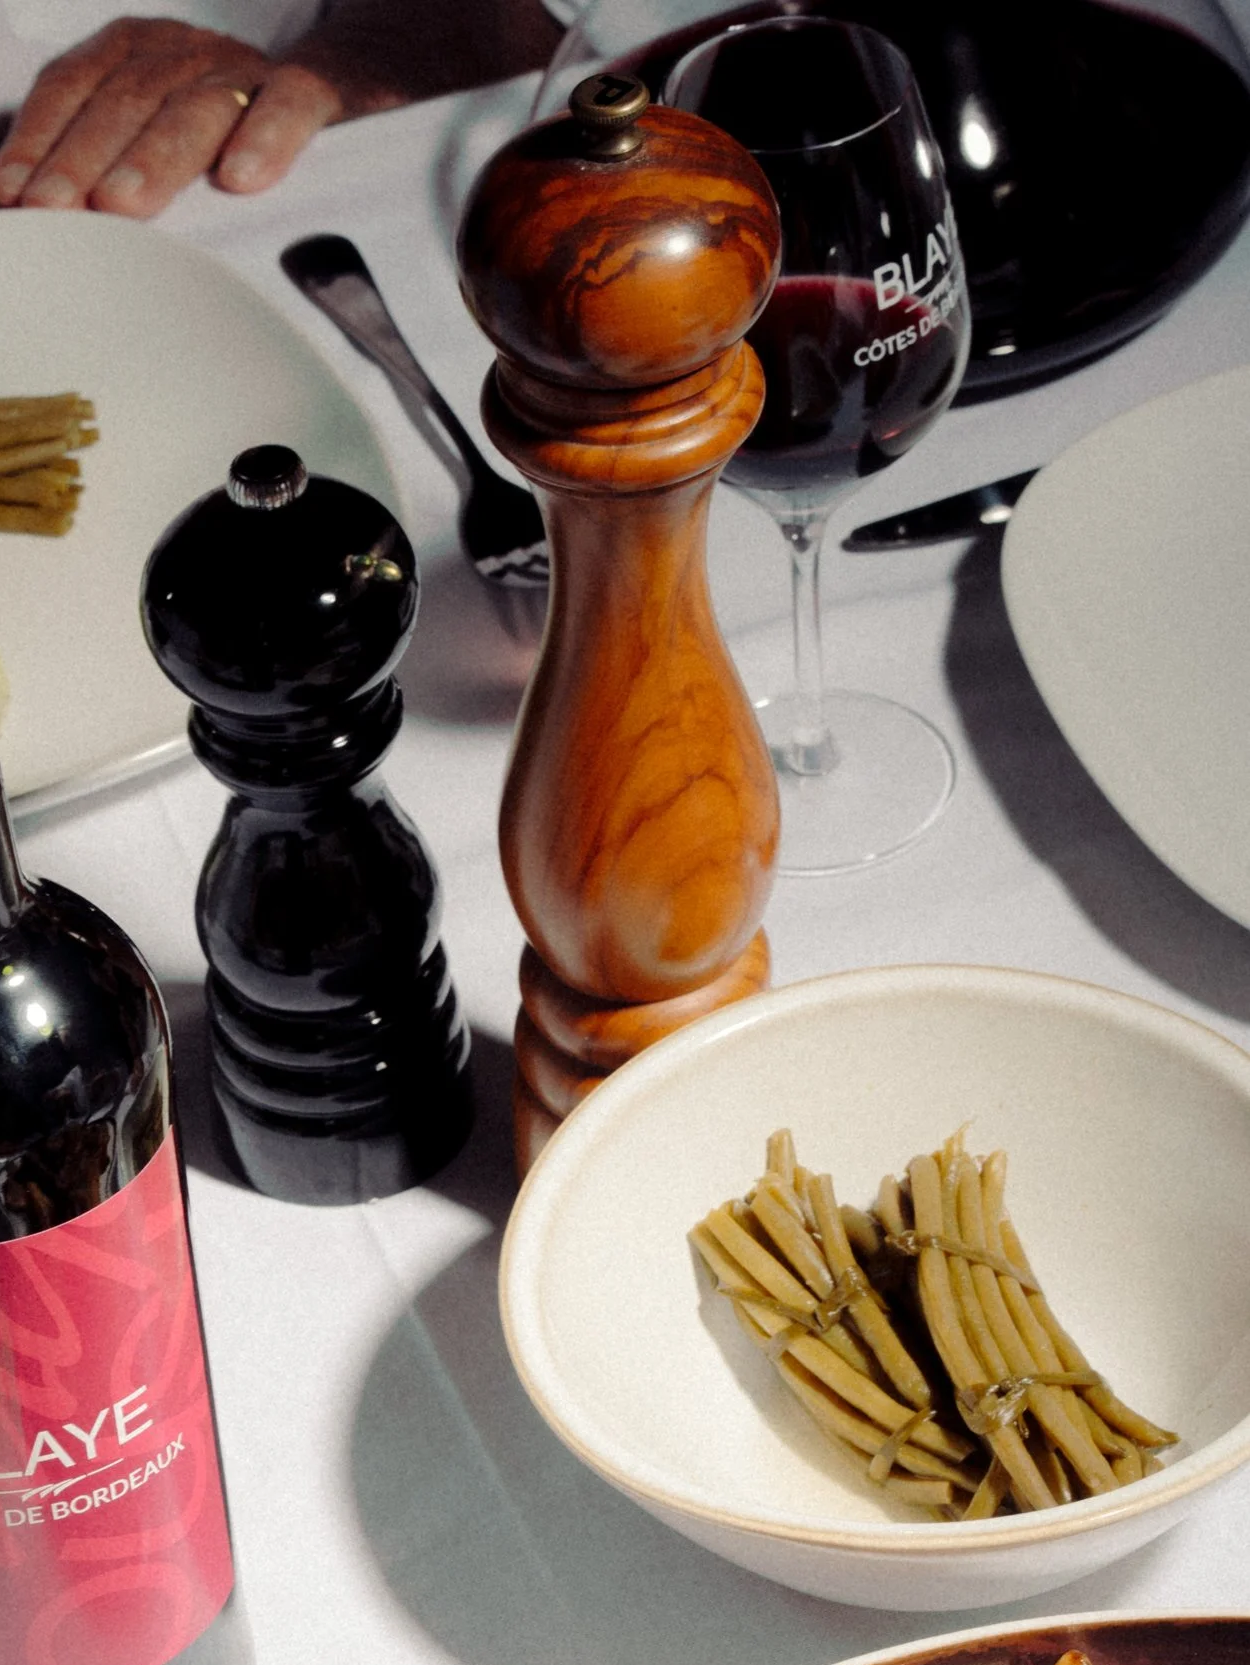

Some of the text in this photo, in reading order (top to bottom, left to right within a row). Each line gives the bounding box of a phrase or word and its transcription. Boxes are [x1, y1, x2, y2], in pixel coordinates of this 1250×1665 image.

[853, 311, 942, 367] CÔTES DE
[5, 1506, 43, 1528] DE
[51, 1432, 187, 1521] BORDEAUX
